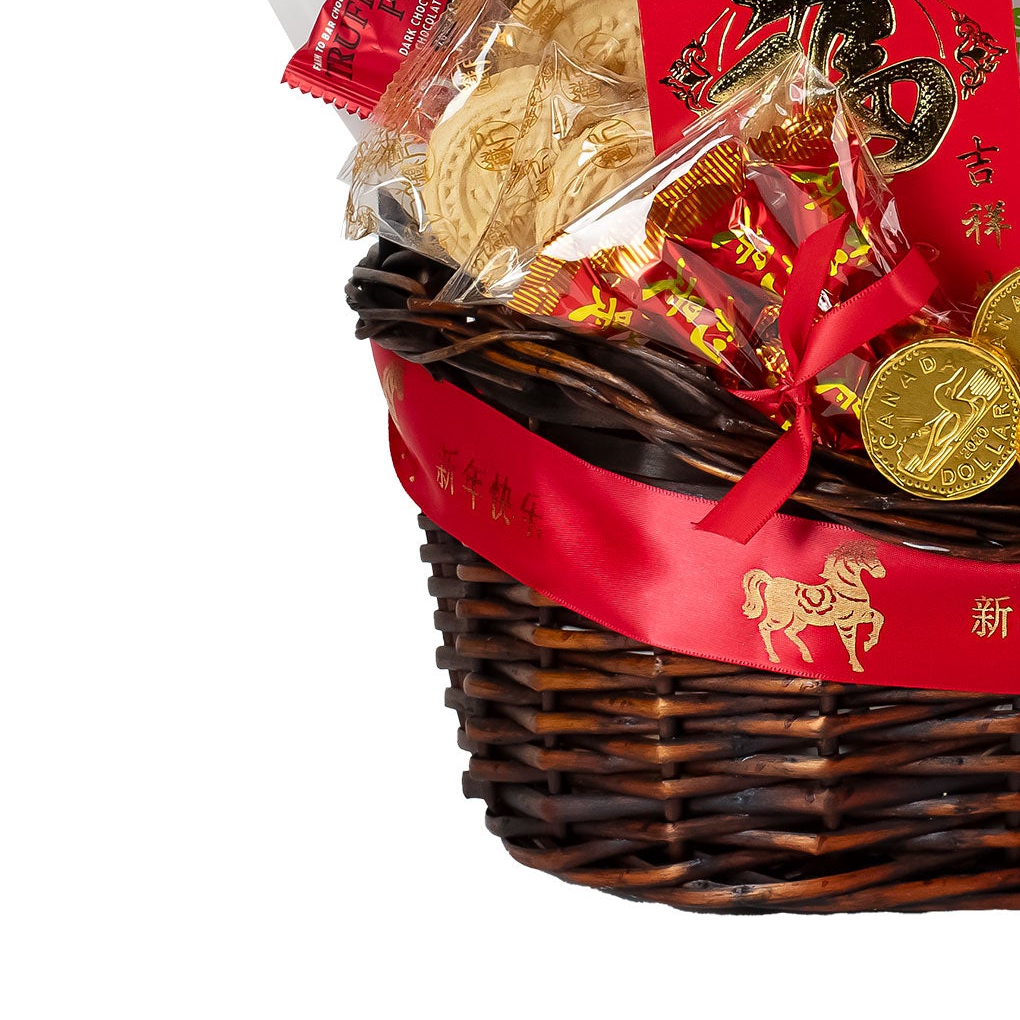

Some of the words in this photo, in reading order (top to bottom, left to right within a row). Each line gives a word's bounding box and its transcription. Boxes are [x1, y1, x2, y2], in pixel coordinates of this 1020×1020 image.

[315, 39, 326, 53] TO
[322, 20, 337, 42] BAR
[398, 27, 417, 57] DARK
[415, 0, 442, 51] CHOCOLAT
[876, 355, 957, 450] CANADA
[940, 403, 1012, 486] DOLLAR
